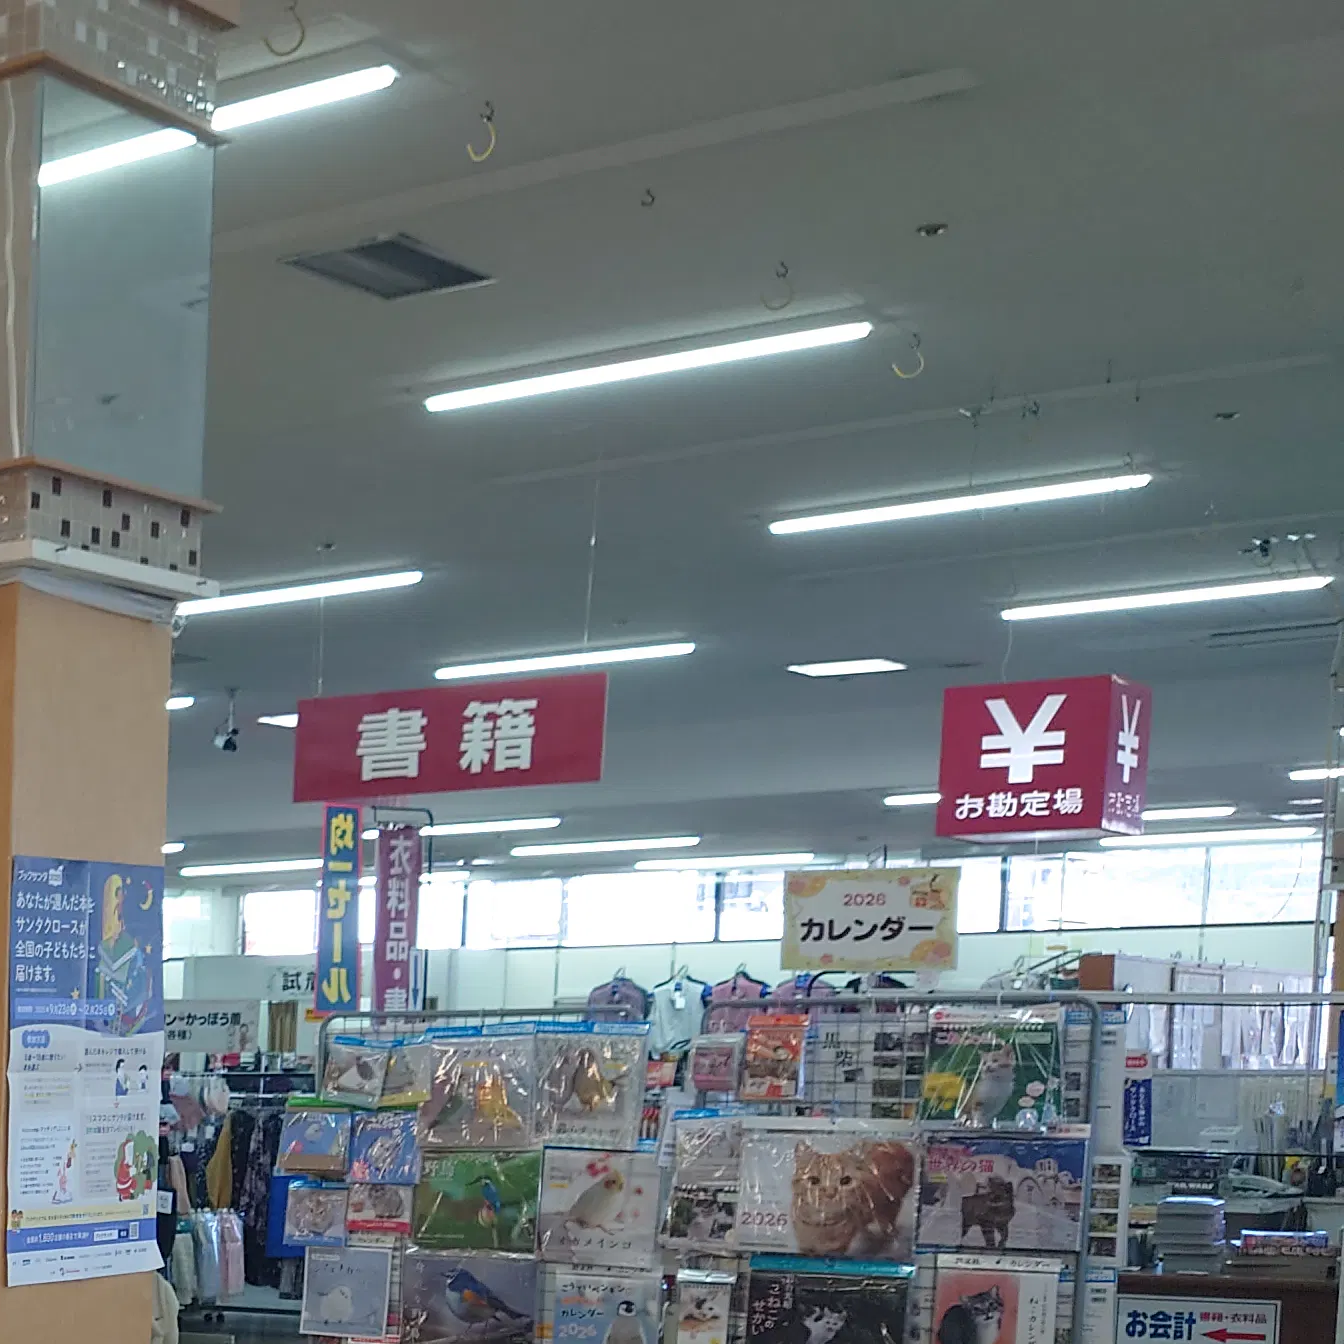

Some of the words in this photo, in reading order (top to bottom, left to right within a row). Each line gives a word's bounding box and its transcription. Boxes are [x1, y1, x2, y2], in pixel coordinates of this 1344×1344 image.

[356, 698, 538, 782] 書籍
[955, 788, 1084, 820] お勘定場
[16, 893, 95, 912] あなたが選んだ本を
[843, 893, 886, 906] 2026
[16, 916, 87, 935] サンタクロースが
[800, 917, 934, 942] カレンダー
[15, 964, 56, 982] 届けます。
[741, 1211, 788, 1227] 2026
[1125, 1310, 1197, 1341] お会計
